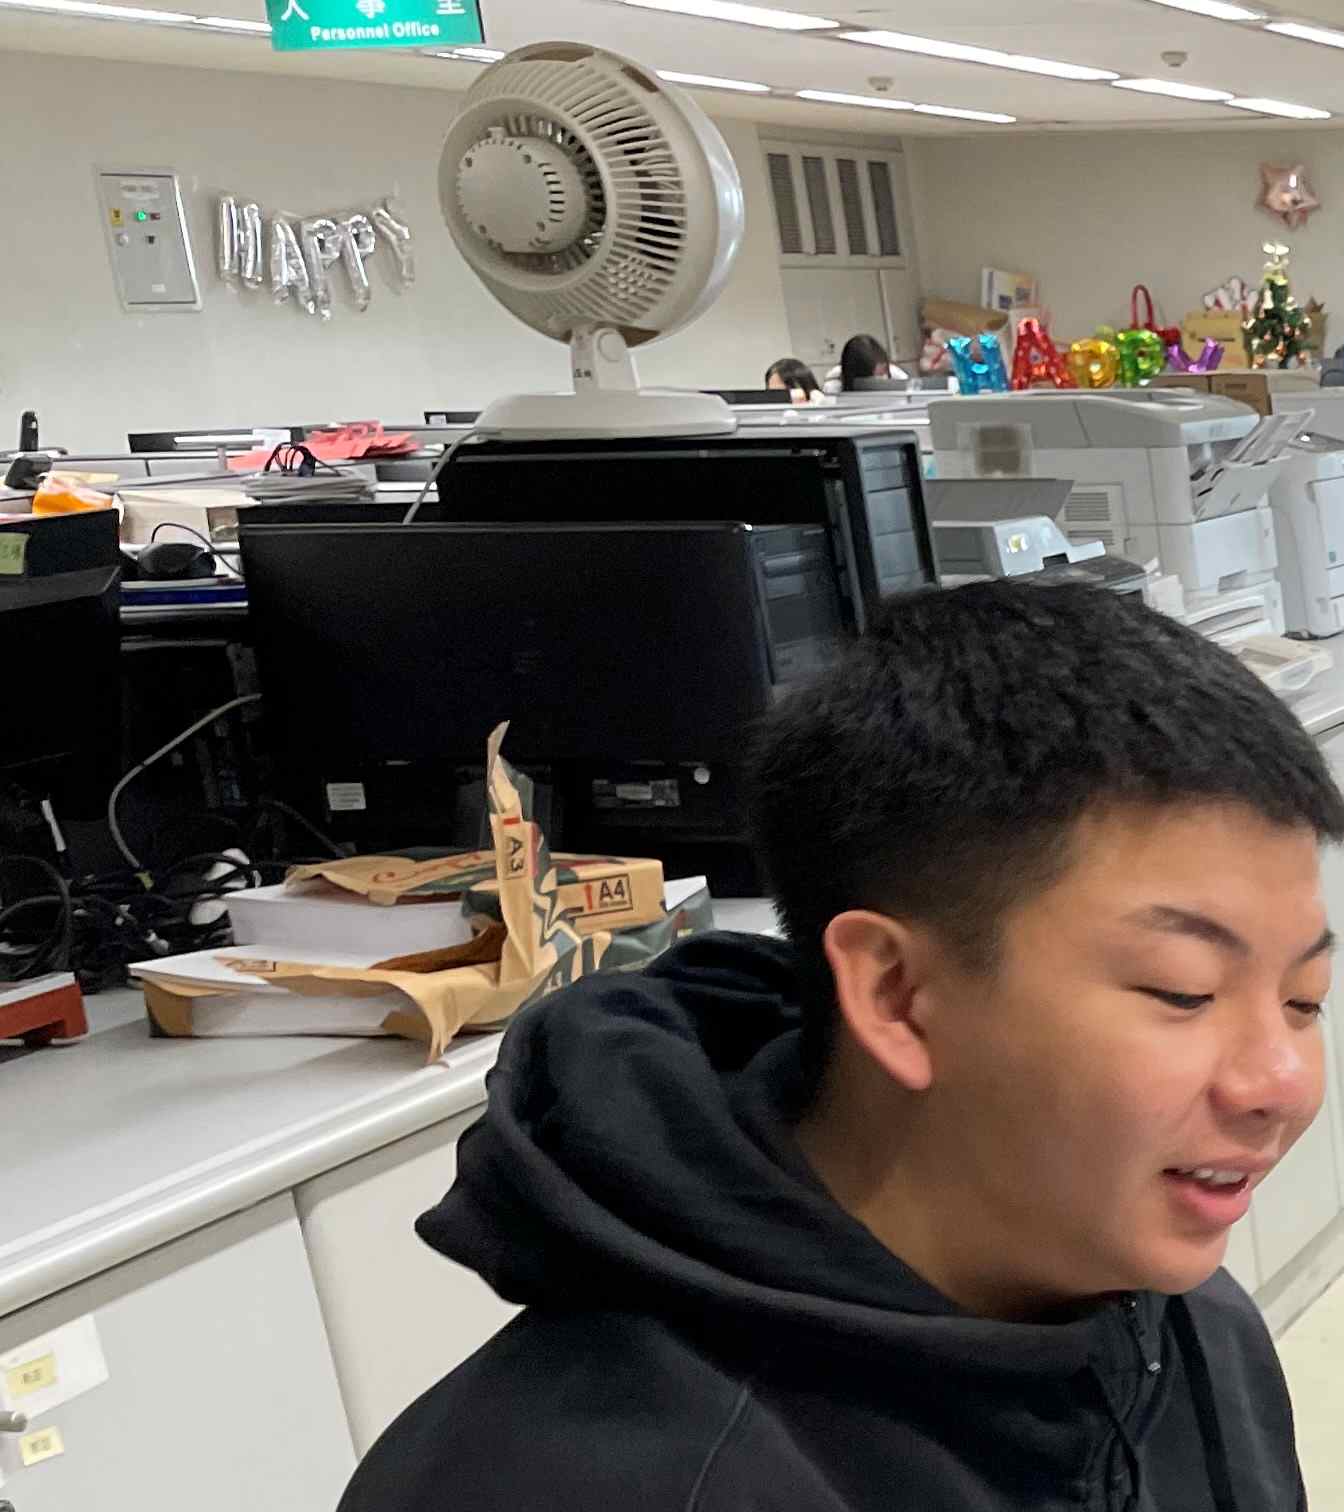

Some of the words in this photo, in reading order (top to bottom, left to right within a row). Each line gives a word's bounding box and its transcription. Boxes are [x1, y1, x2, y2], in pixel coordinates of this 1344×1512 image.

[310, 22, 390, 41] Personnel
[392, 20, 440, 38] Office
[220, 196, 415, 321] HAPPY
[505, 836, 524, 872] A3
[600, 879, 625, 901] A4
